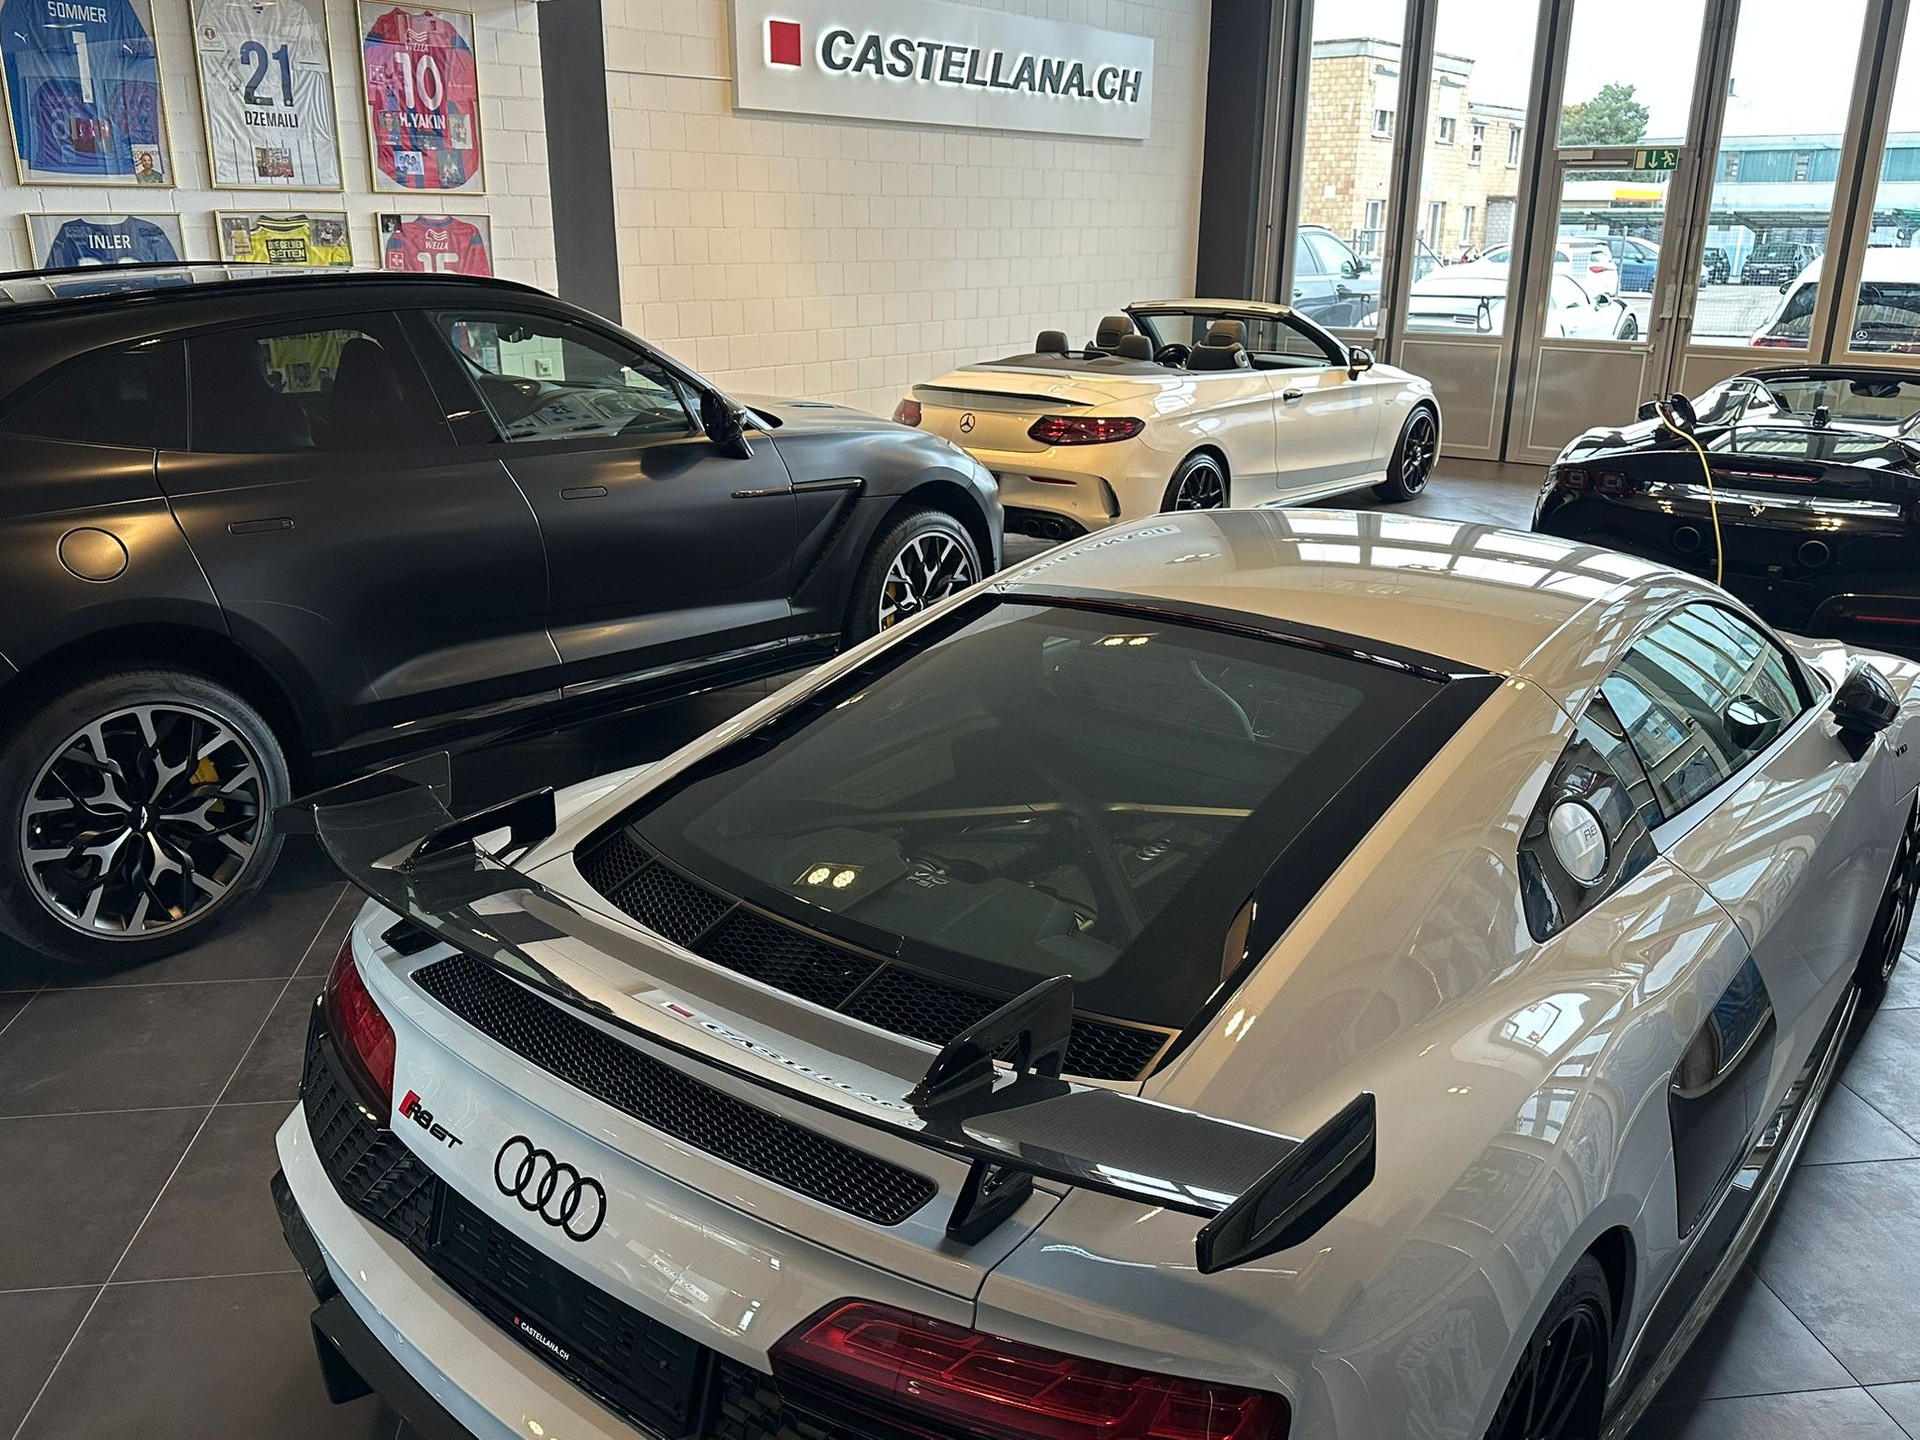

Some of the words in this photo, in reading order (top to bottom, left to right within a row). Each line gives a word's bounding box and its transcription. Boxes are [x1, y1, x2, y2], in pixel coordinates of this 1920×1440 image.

[48, 1, 107, 23] SOMMER
[72, 31, 94, 103] 1
[240, 40, 294, 107] 21
[821, 29, 1143, 103] CASTELLANA.CH
[394, 51, 443, 111] 10
[244, 110, 299, 128] DZEMAILI
[399, 111, 446, 130] H.YAKIN
[88, 234, 132, 249] INLER
[425, 240, 449, 250] WELLA
[269, 249, 306, 258] SEITEN
[1583, 824, 1599, 841] R8
[408, 1102, 434, 1129] R8
[429, 1124, 463, 1149] GT
[520, 1321, 570, 1361] CASTELLANA.CH
